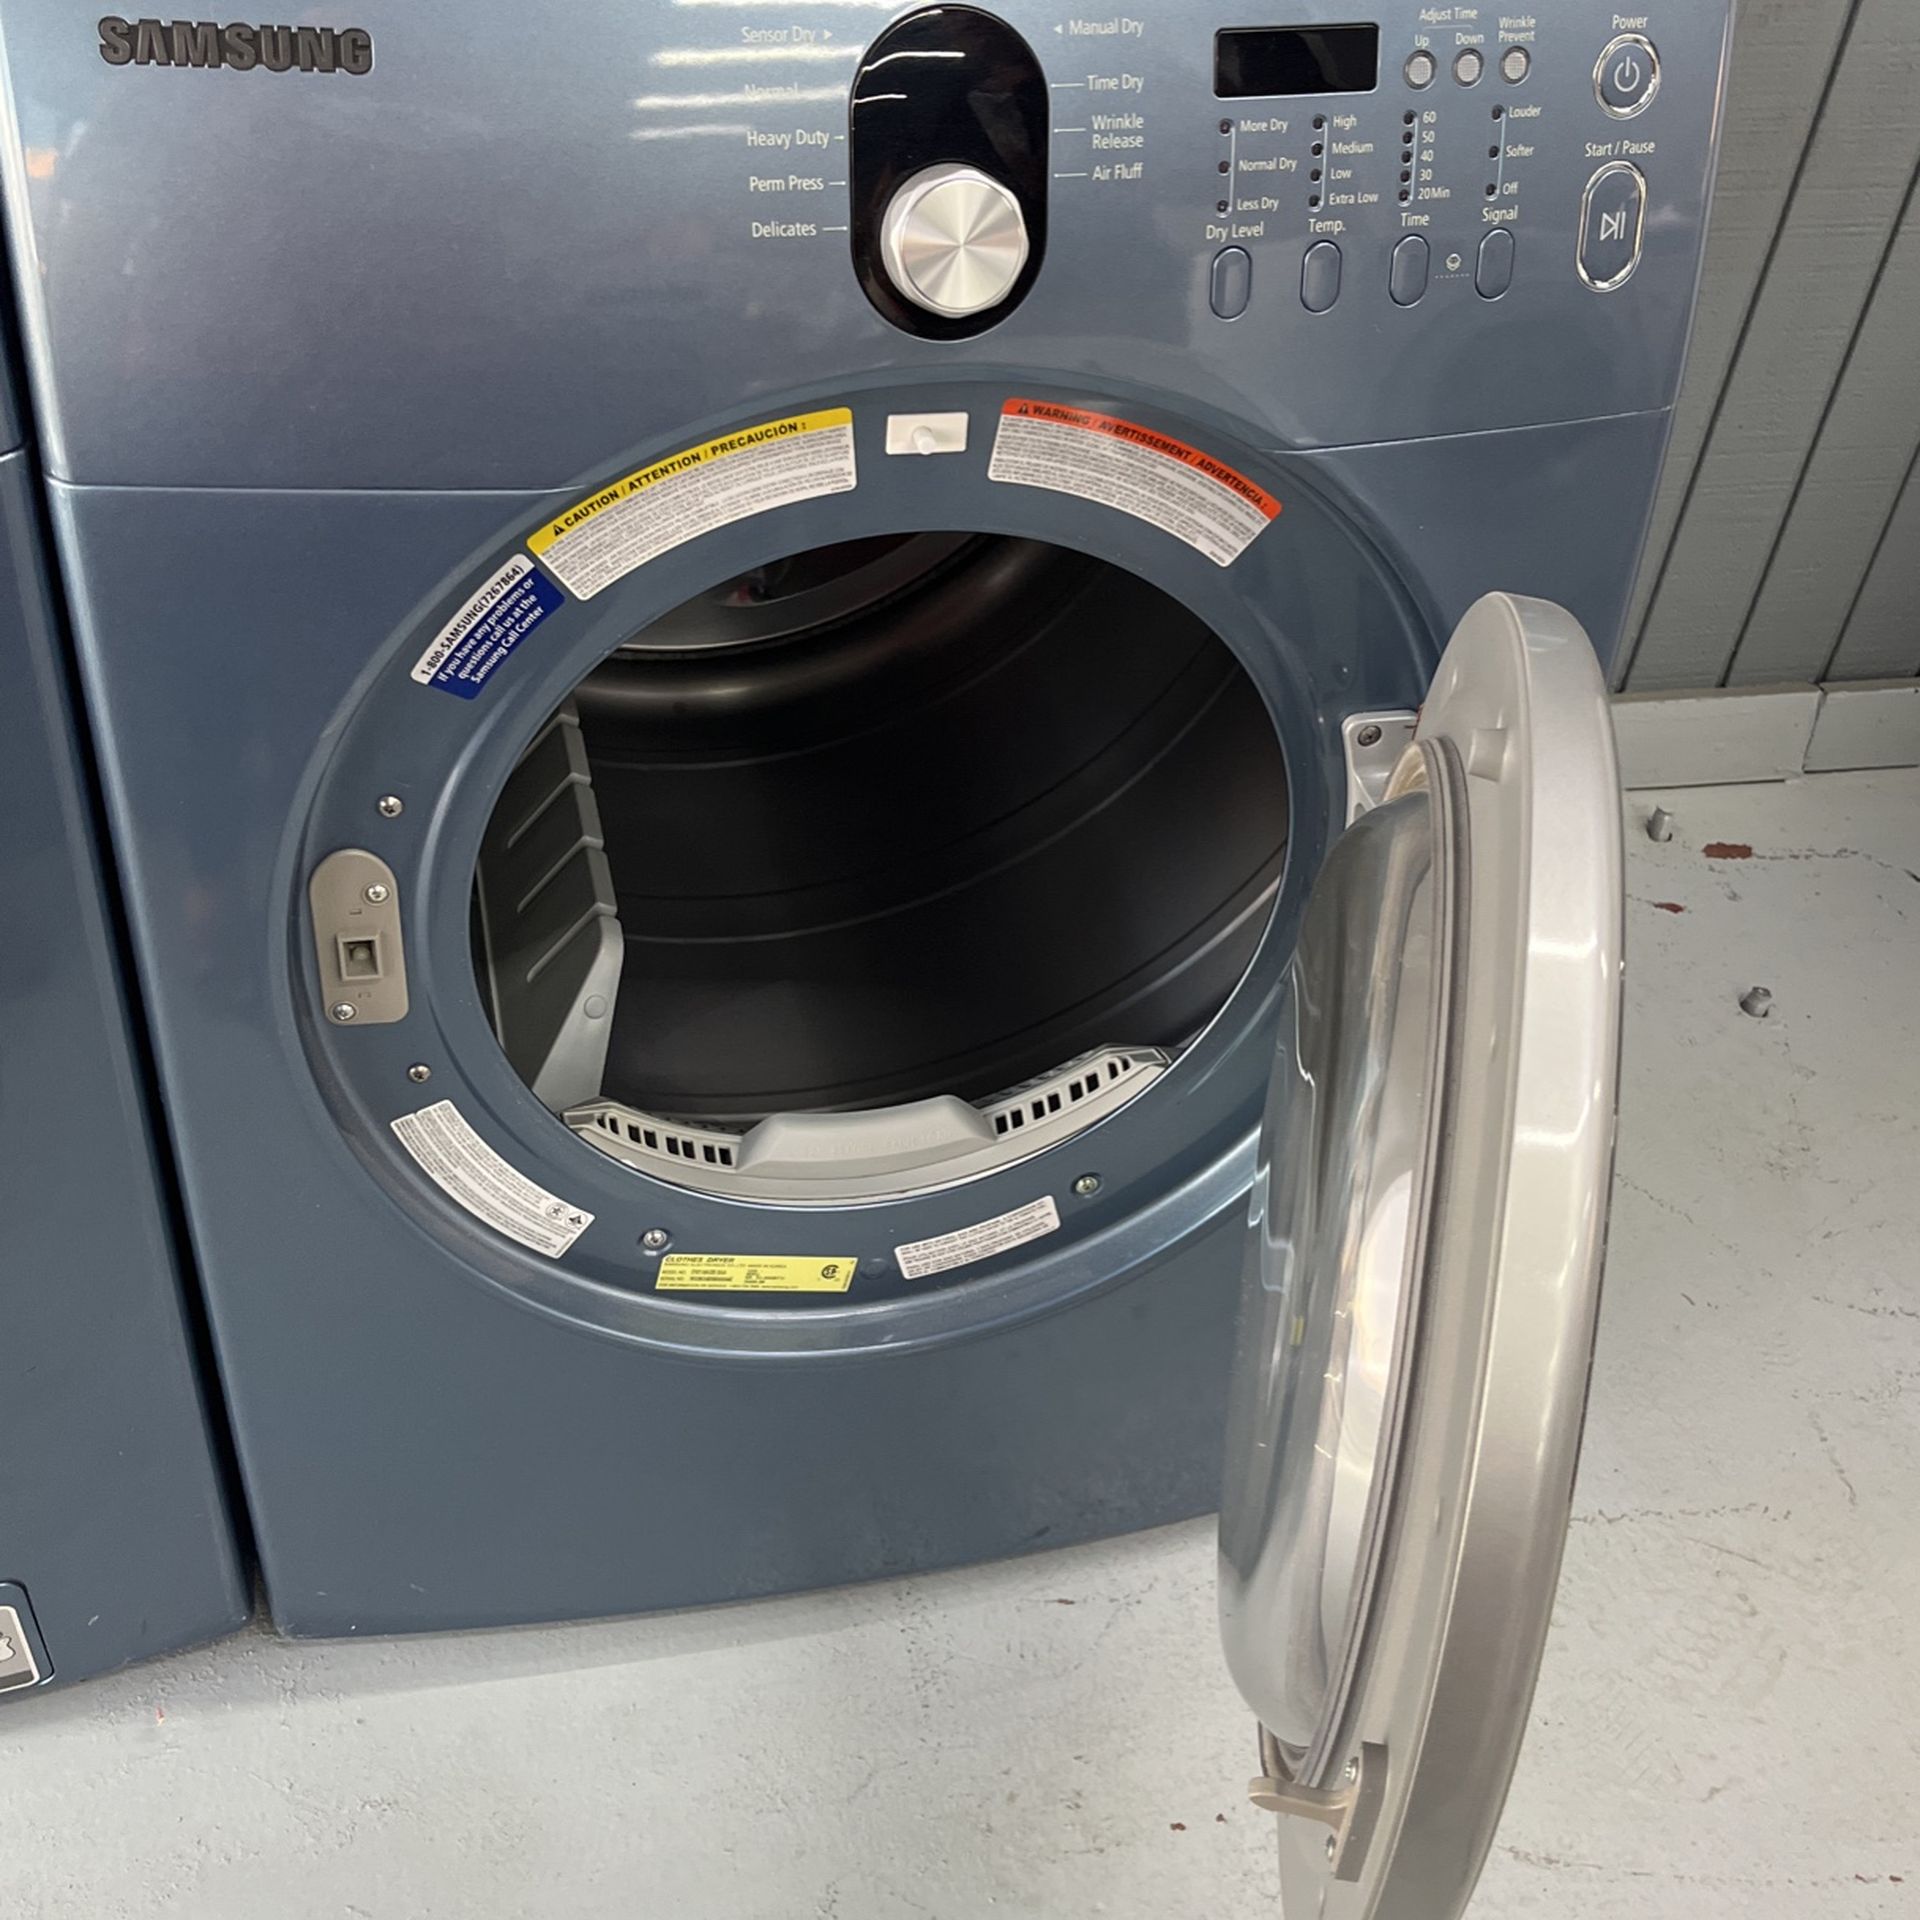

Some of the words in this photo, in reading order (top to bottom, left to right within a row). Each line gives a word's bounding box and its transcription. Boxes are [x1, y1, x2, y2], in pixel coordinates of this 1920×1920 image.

[1418, 8, 1452, 21] Adjust
[1453, 7, 1478, 20] Time
[1611, 15, 1649, 29] Power
[1068, 18, 1119, 36] Manual
[1121, 17, 1144, 37] Dry
[1499, 16, 1536, 29] Wrinkle
[741, 26, 789, 44] Sensor
[791, 25, 817, 45] Dry
[1414, 34, 1430, 48] Up
[1455, 32, 1485, 45] Down
[1498, 29, 1536, 42] Prevent
[97, 15, 374, 76] SAMSUNG
[744, 81, 799, 98] Normal
[1086, 74, 1119, 91] Time
[1121, 74, 1144, 93] Dry
[1422, 112, 1437, 124] 60
[1508, 105, 1542, 119] Louder
[1092, 113, 1145, 130] Wrinkle
[1240, 120, 1267, 132] More
[1269, 119, 1288, 134] Dry
[1333, 116, 1358, 130] High
[746, 130, 792, 150] Heavy
[795, 128, 830, 149] Duty
[1092, 132, 1144, 150] Release
[1421, 131, 1436, 143] 50
[1332, 141, 1374, 154] Medium
[1506, 145, 1535, 157] Softer
[1585, 142, 1611, 157] Start
[1621, 140, 1656, 155] Pause
[1420, 150, 1434, 162] 40
[1092, 164, 1112, 181] Air
[1113, 162, 1144, 180] Fluff
[1239, 158, 1277, 172] Normal
[1279, 157, 1298, 173] Dry
[1330, 168, 1352, 180] Low
[1419, 169, 1433, 181] 30
[749, 176, 786, 192] Perm
[788, 175, 825, 191] Press
[1502, 181, 1519, 195] Off
[1329, 193, 1356, 206] Extra
[1358, 192, 1380, 204] Low
[1417, 187, 1451, 200] 20Min
[1237, 198, 1260, 211] Less
[1261, 196, 1280, 212] Dry
[1401, 213, 1430, 227] Time
[1481, 206, 1519, 223] Signal
[751, 221, 817, 238] Delicates
[1205, 224, 1229, 242] Dry
[1231, 222, 1265, 239] Level
[1309, 219, 1347, 235] Temp.
[1032, 404, 1092, 426] WARNING
[1098, 421, 1193, 467] AVERTISSEMENT
[1196, 458, 1265, 506] ADVERTENCIA
[563, 489, 621, 527] CAUTION
[628, 451, 702, 492] ATTENTION
[710, 421, 798, 456] PRECAUCIÓN
[437, 670, 448, 683] If
[444, 656, 461, 677] you
[458, 636, 478, 661] have
[475, 621, 493, 641] any
[487, 586, 526, 627] problems
[523, 578, 535, 590] or
[457, 639, 495, 681] questions
[489, 624, 506, 643] call
[503, 615, 516, 628] us
[514, 606, 526, 619] at
[520, 593, 538, 610] the
[470, 646, 509, 684] Samsung
[500, 630, 521, 649] Call
[515, 605, 545, 633] Center
